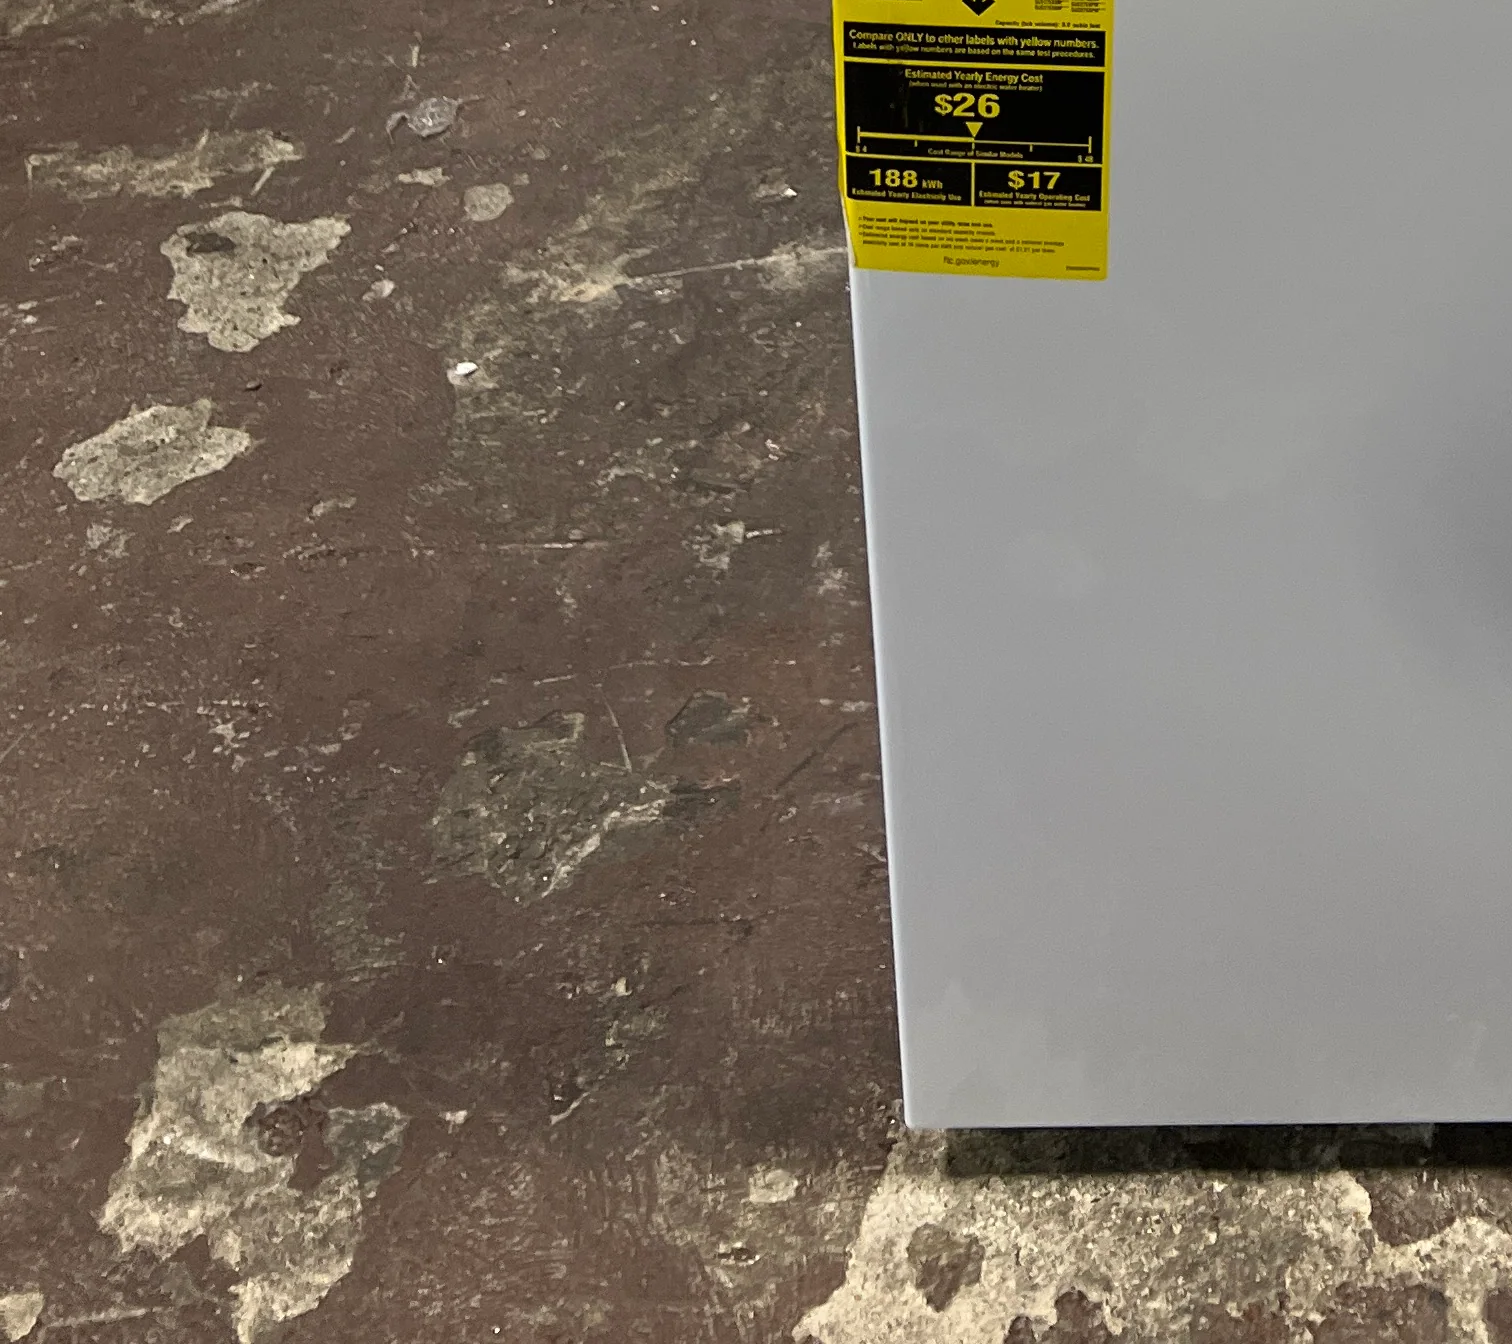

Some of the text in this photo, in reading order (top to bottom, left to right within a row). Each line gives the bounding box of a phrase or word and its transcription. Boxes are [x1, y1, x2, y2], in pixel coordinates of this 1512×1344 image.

[848, 30, 1100, 50] Compare ONLY to other labels with yellow numbers.
[904, 69, 1044, 84] Estimated Yearly Energy Cost
[934, 92, 1000, 118] $26
[868, 168, 944, 190] 188 kWh
[1008, 170, 1061, 190] $17
